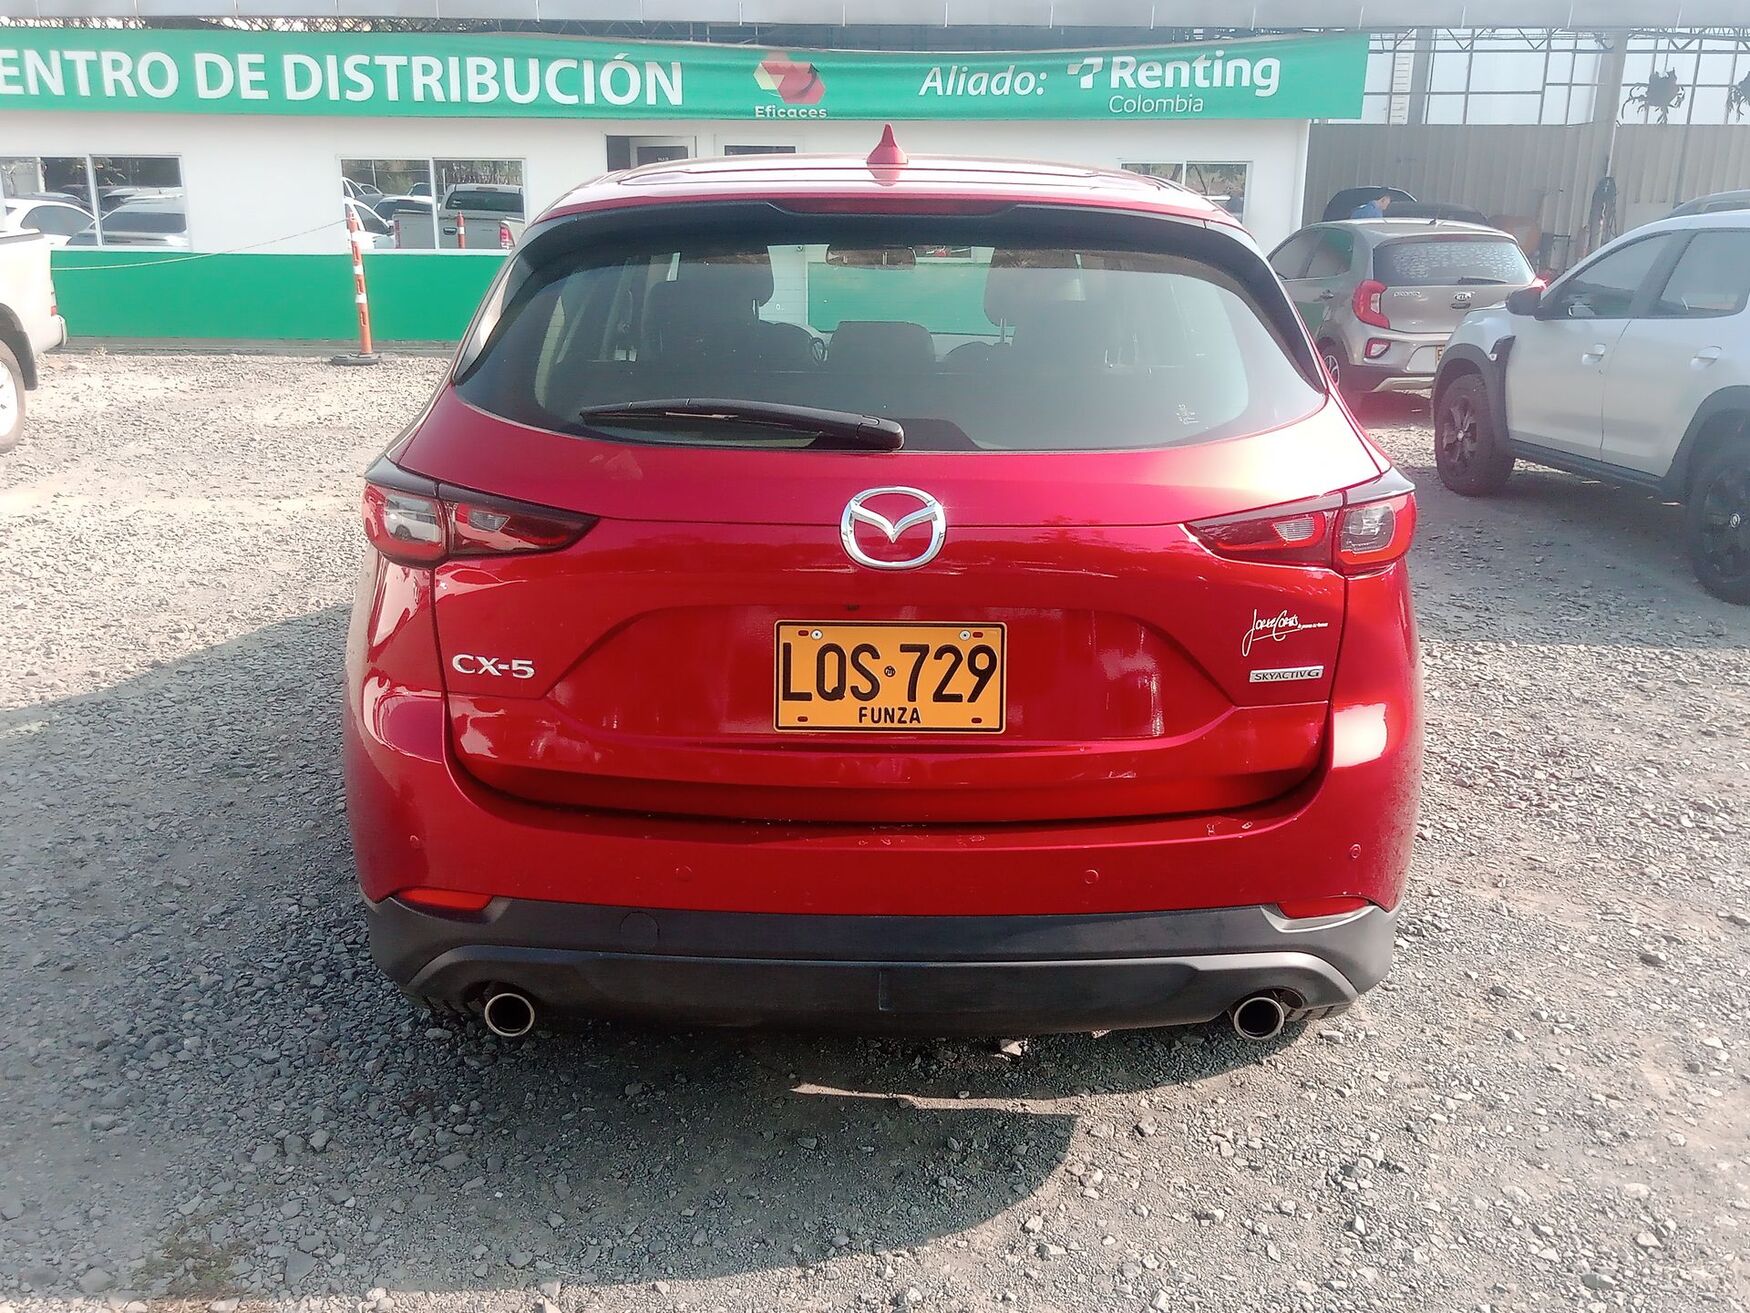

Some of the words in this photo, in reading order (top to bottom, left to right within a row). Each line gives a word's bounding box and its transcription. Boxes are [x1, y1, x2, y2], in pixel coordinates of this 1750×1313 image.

[194, 52, 269, 101] DE
[283, 52, 683, 106] DISTRIBUCIÓN
[919, 65, 1048, 97] Aliado:
[1110, 50, 1281, 97] Renting
[755, 105, 828, 119] Eficaces
[1109, 95, 1204, 113] Colombia
[452, 653, 535, 679] CX-5
[858, 706, 921, 724] FUNZA
